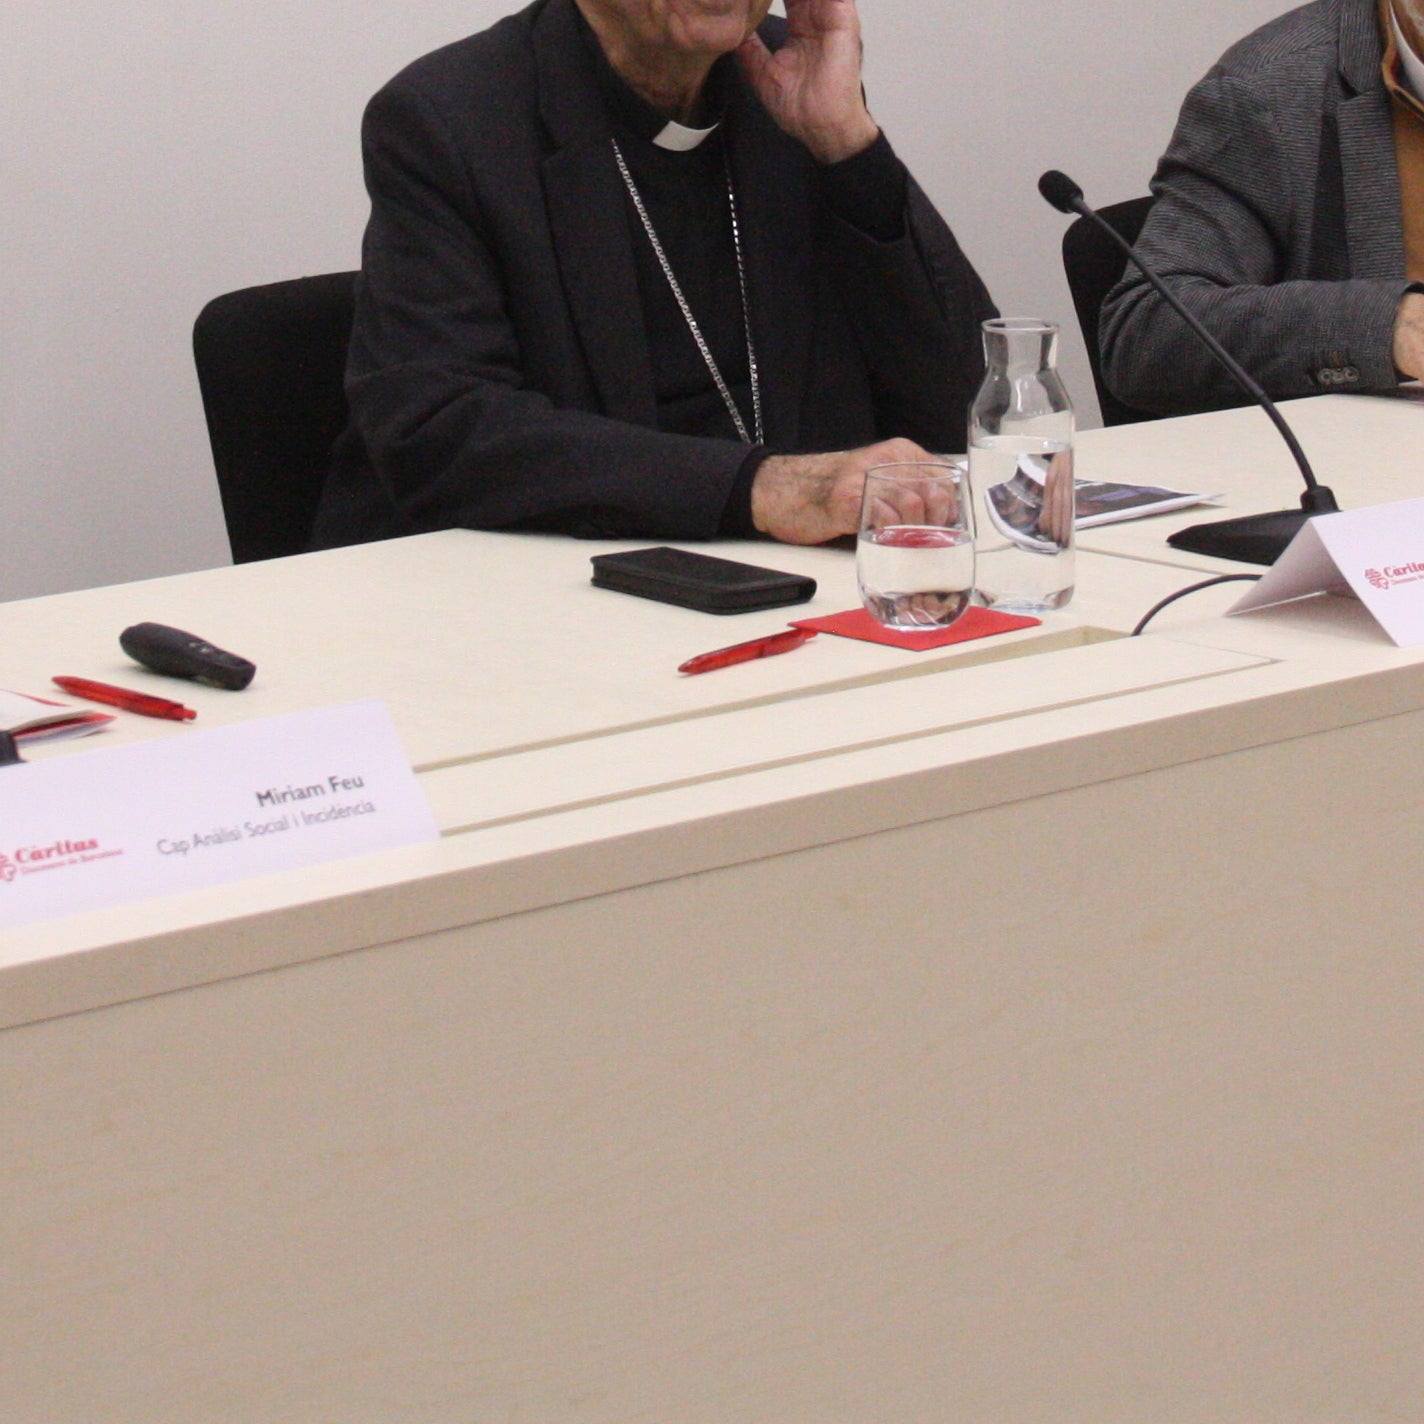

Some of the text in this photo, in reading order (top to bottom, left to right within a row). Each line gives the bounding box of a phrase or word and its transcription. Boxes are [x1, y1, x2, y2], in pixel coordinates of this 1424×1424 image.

[256, 775, 365, 807] Miriam Feu
[156, 838, 190, 856] Cap
[244, 815, 290, 838] Social
